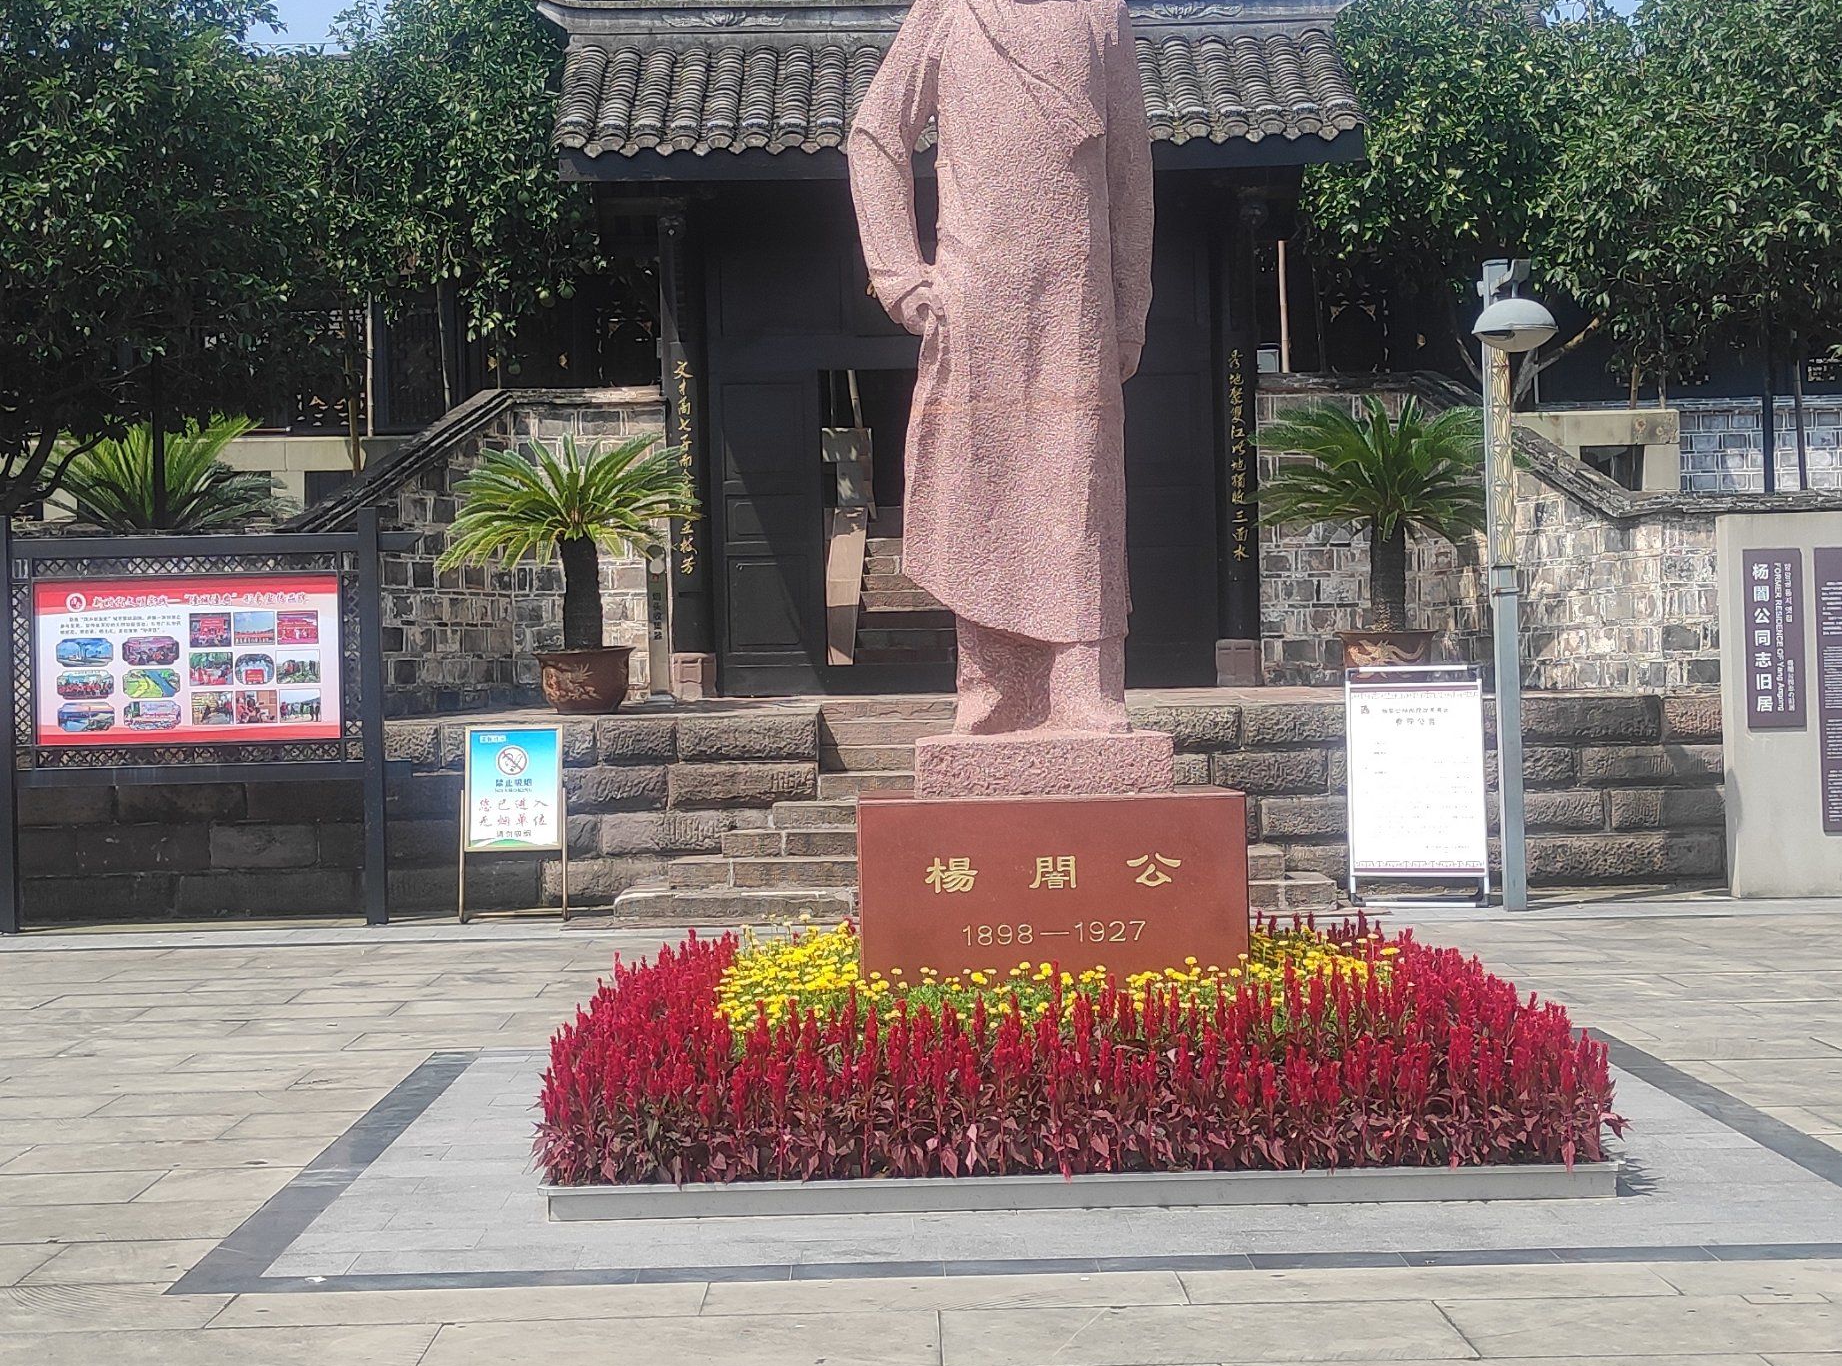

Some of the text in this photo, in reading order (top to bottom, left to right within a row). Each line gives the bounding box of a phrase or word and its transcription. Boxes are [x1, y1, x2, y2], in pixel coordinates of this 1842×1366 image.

[1774, 562, 1782, 598] FORMER
[1752, 563, 1773, 712] 杨闇公同志旧居
[1775, 600, 1783, 647] RESIDENCE
[1776, 648, 1784, 660] OF
[1776, 661, 1785, 681] Yang
[479, 798, 549, 812] 您已进入
[924, 851, 1183, 894] 楊闇公
